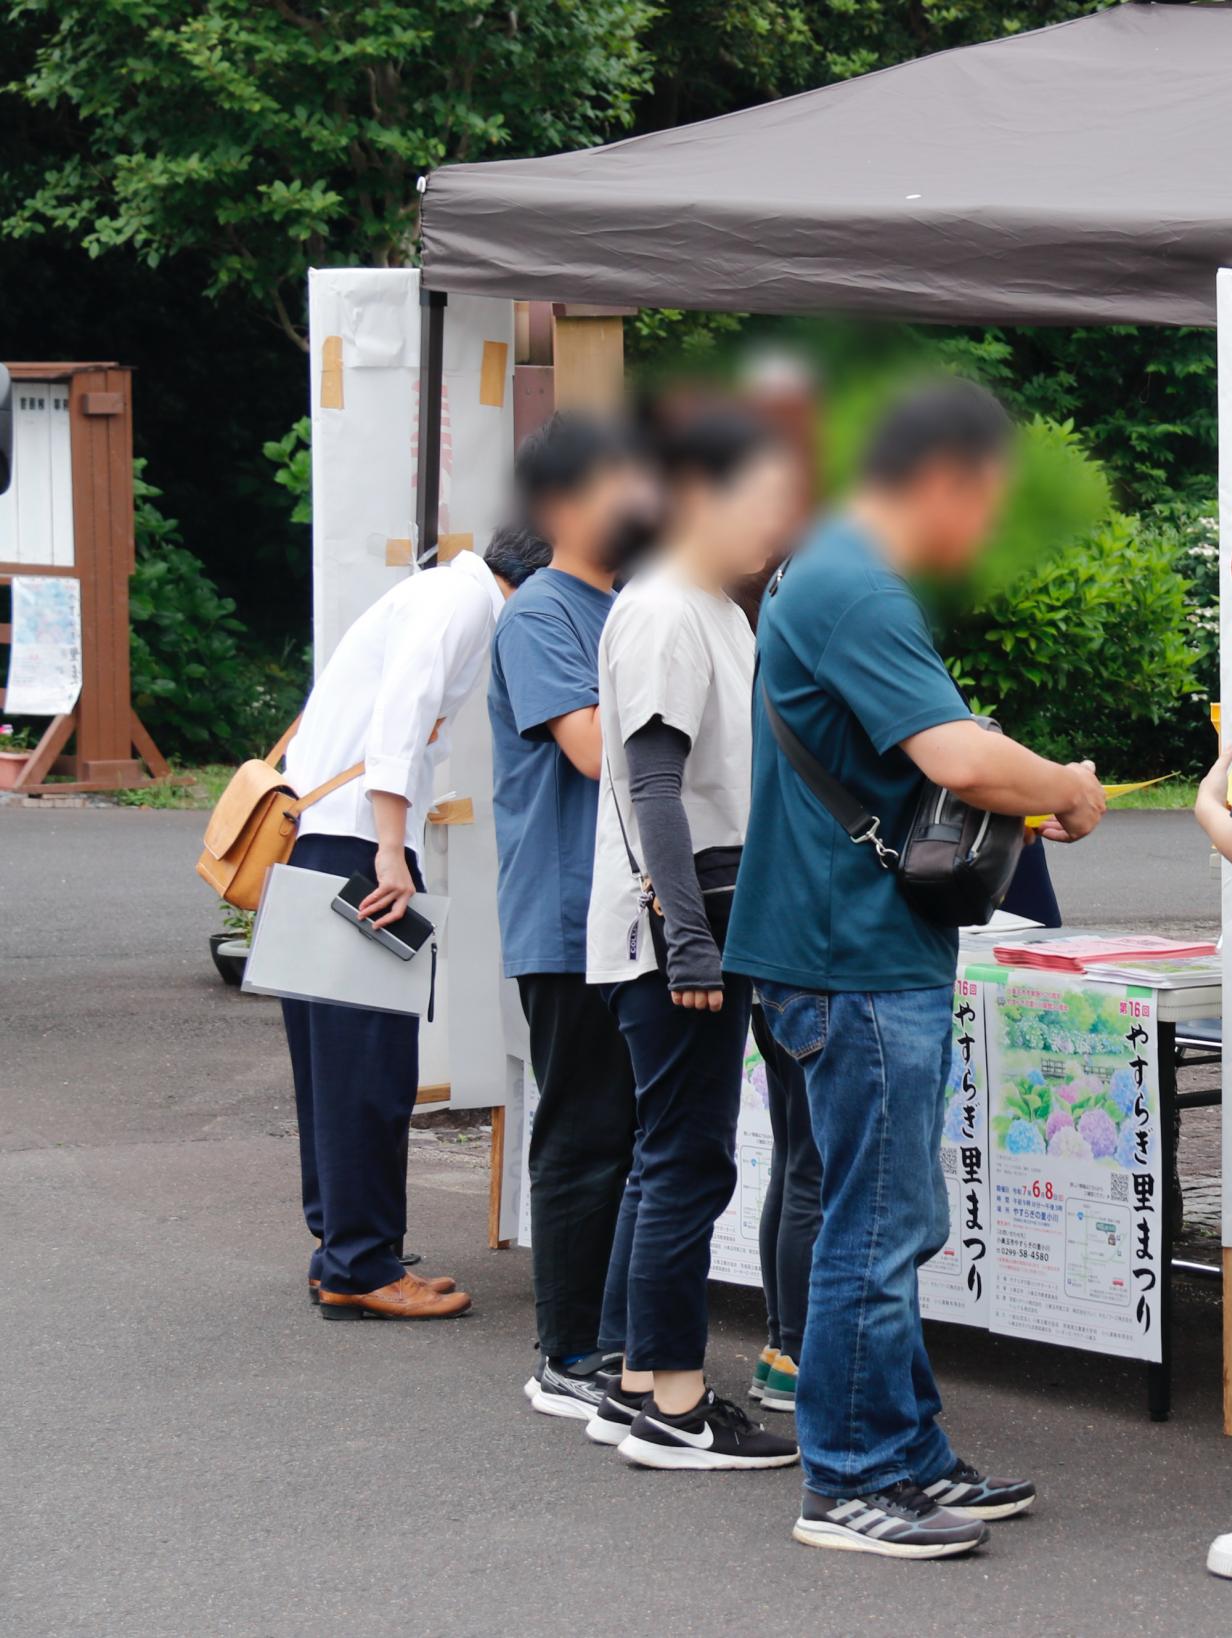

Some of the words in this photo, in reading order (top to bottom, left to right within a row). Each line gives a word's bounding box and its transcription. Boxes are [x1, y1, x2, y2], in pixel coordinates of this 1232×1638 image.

[955, 1002, 986, 1303] やすらぎ里まつり
[1119, 1000, 1150, 1017] 第16回
[1126, 1022, 1156, 1334] やすらぎ里まつり
